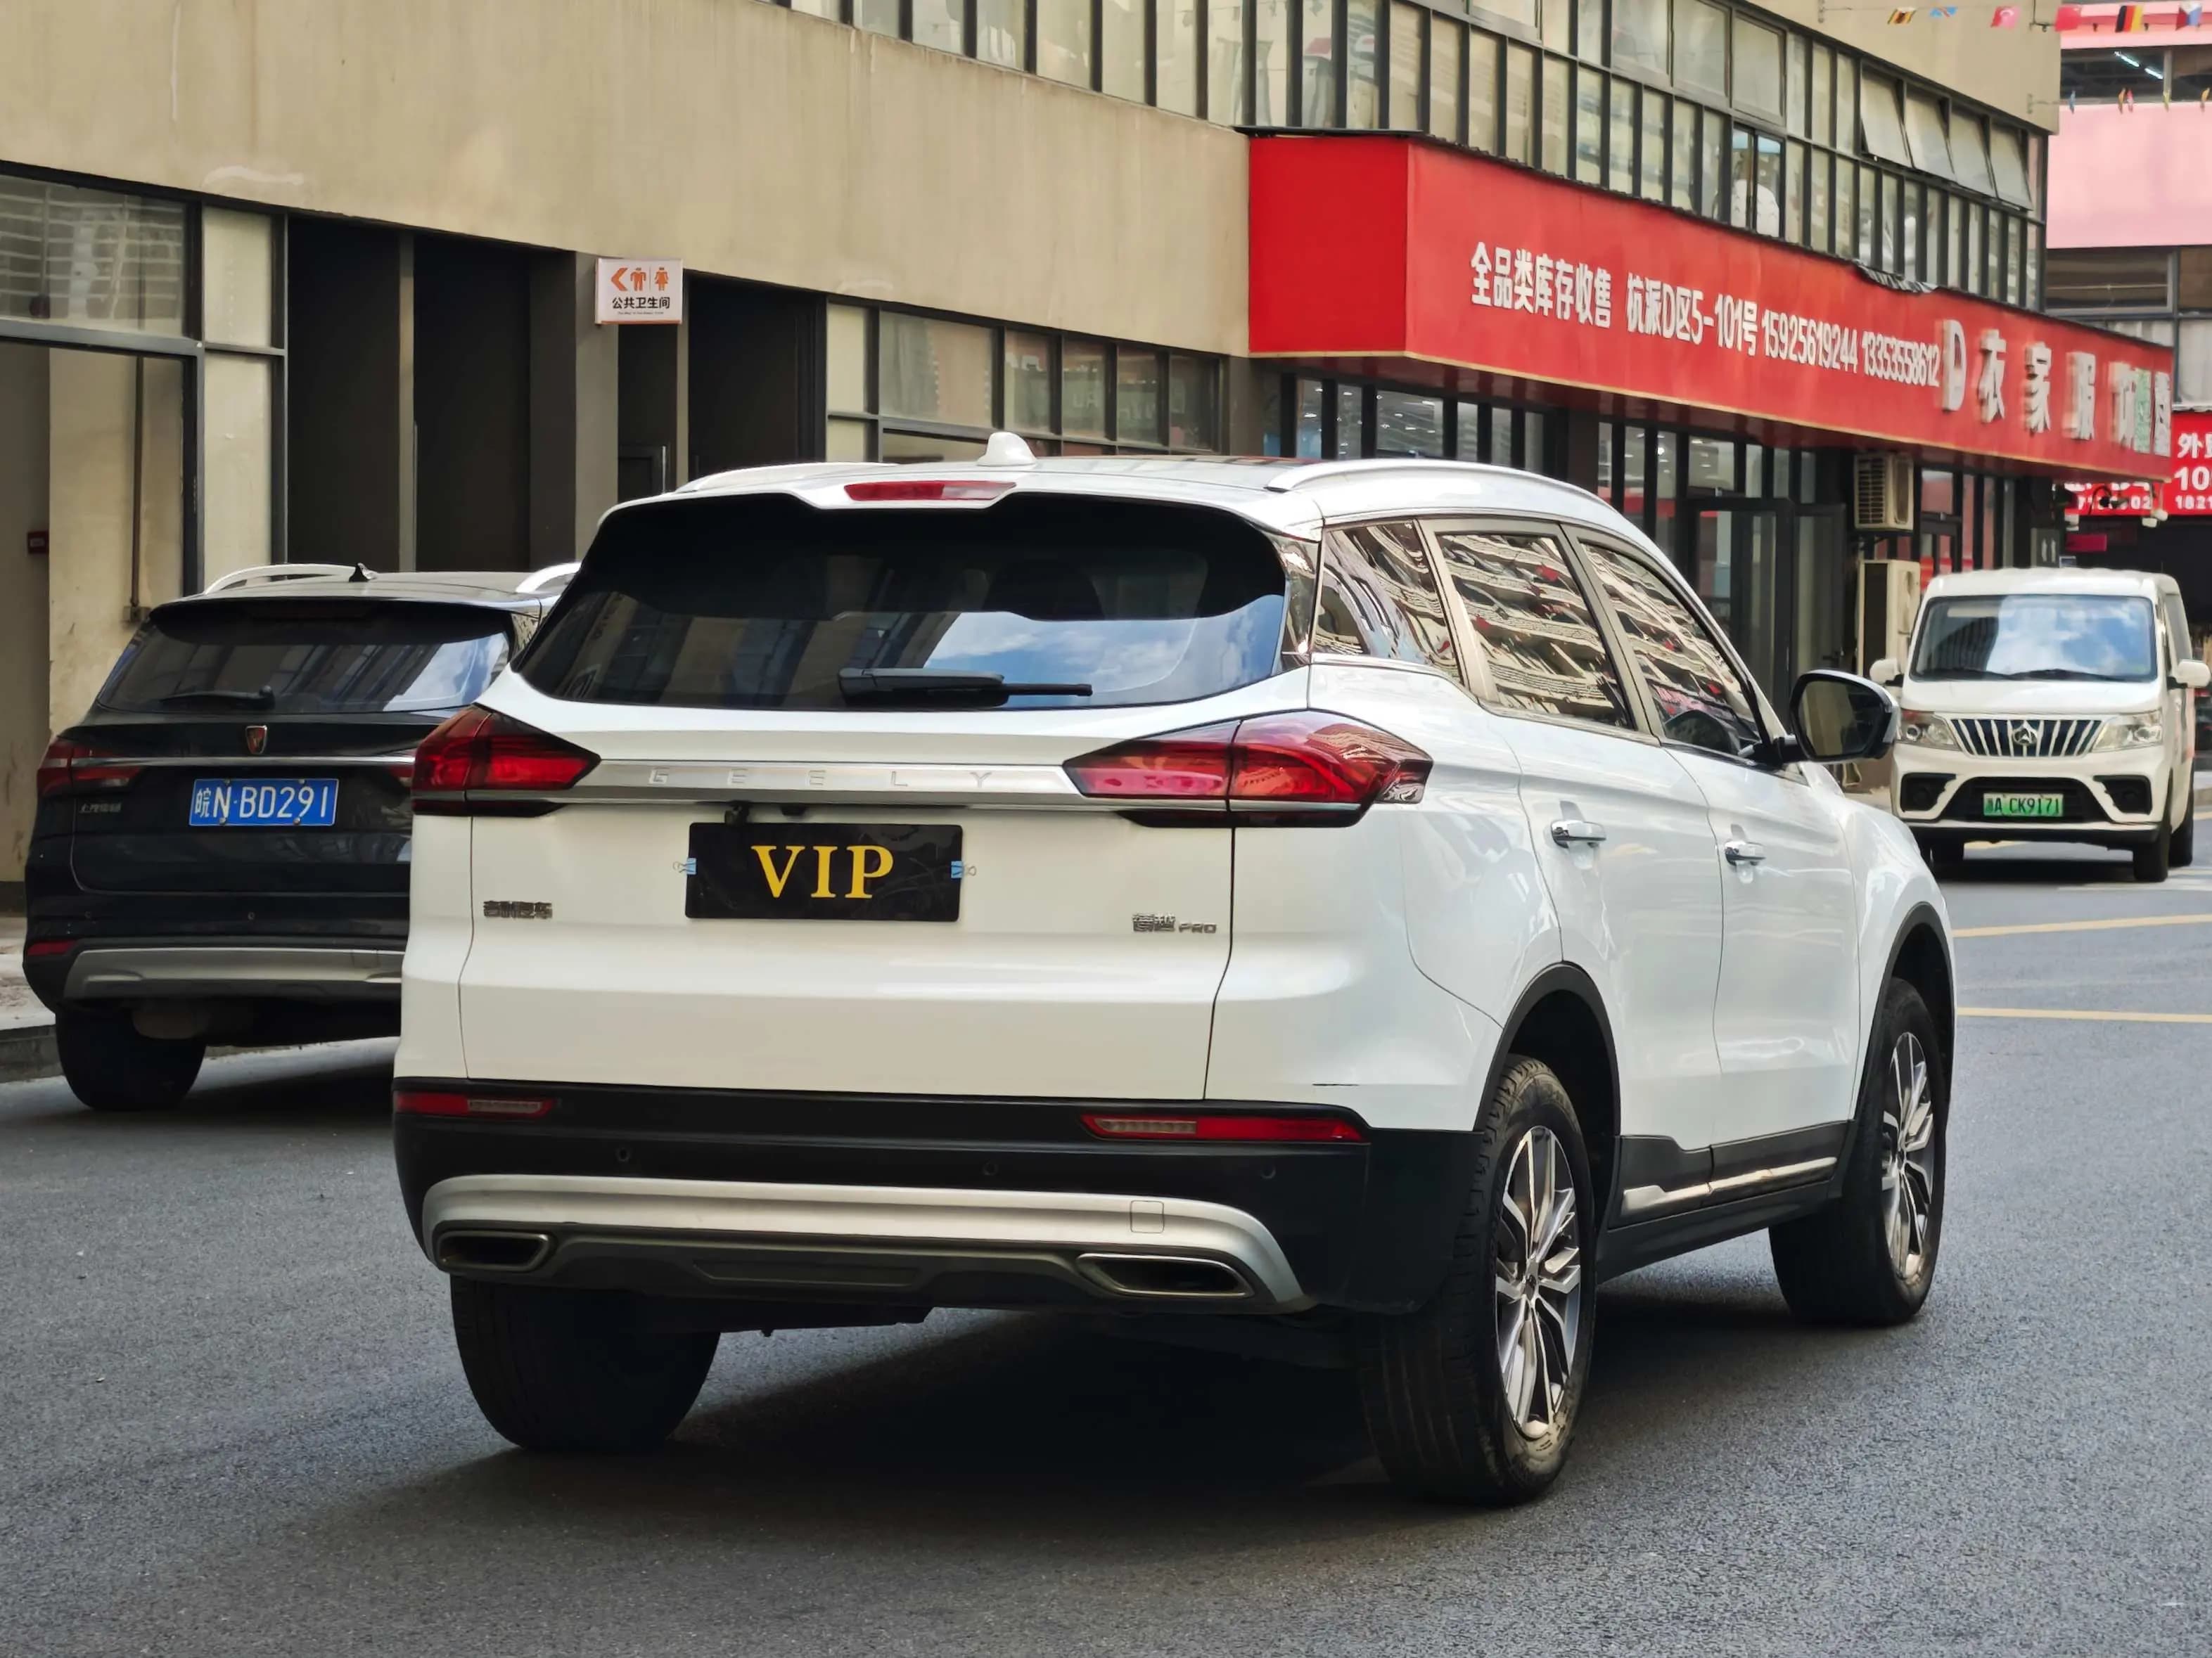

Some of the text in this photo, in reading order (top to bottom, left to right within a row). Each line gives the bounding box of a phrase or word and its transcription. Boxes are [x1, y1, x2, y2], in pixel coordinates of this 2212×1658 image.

[612, 297, 670, 309] 公共卫生间
[1471, 241, 1611, 328] 全品类库存收售
[1762, 309, 1858, 373] 15925619244
[2178, 432, 2212, 458] 外
[648, 767, 992, 788] GEELY
[751, 844, 895, 899] VIP
